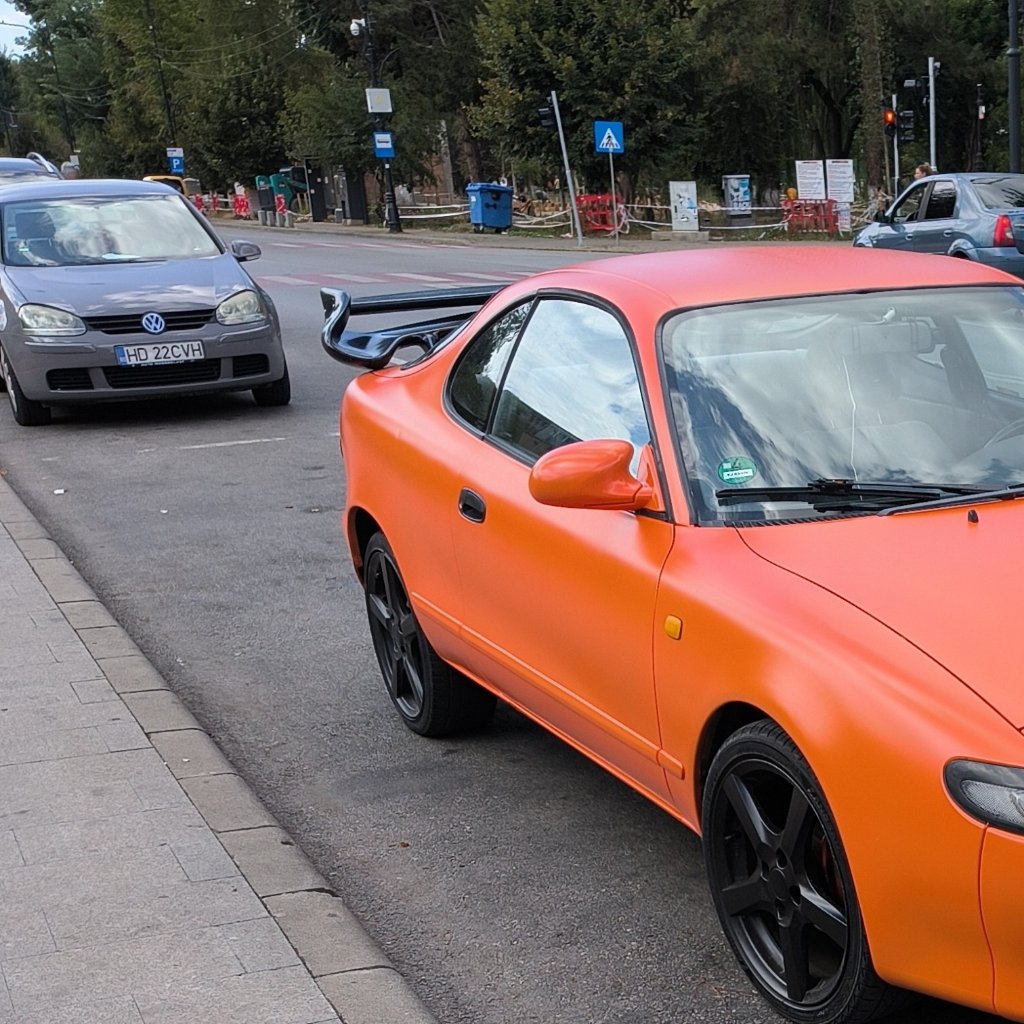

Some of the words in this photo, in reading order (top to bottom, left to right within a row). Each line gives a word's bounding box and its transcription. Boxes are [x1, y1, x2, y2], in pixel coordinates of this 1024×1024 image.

[172, 158, 180, 169] P
[126, 347, 148, 362] HD
[153, 343, 202, 360] 22CVH
